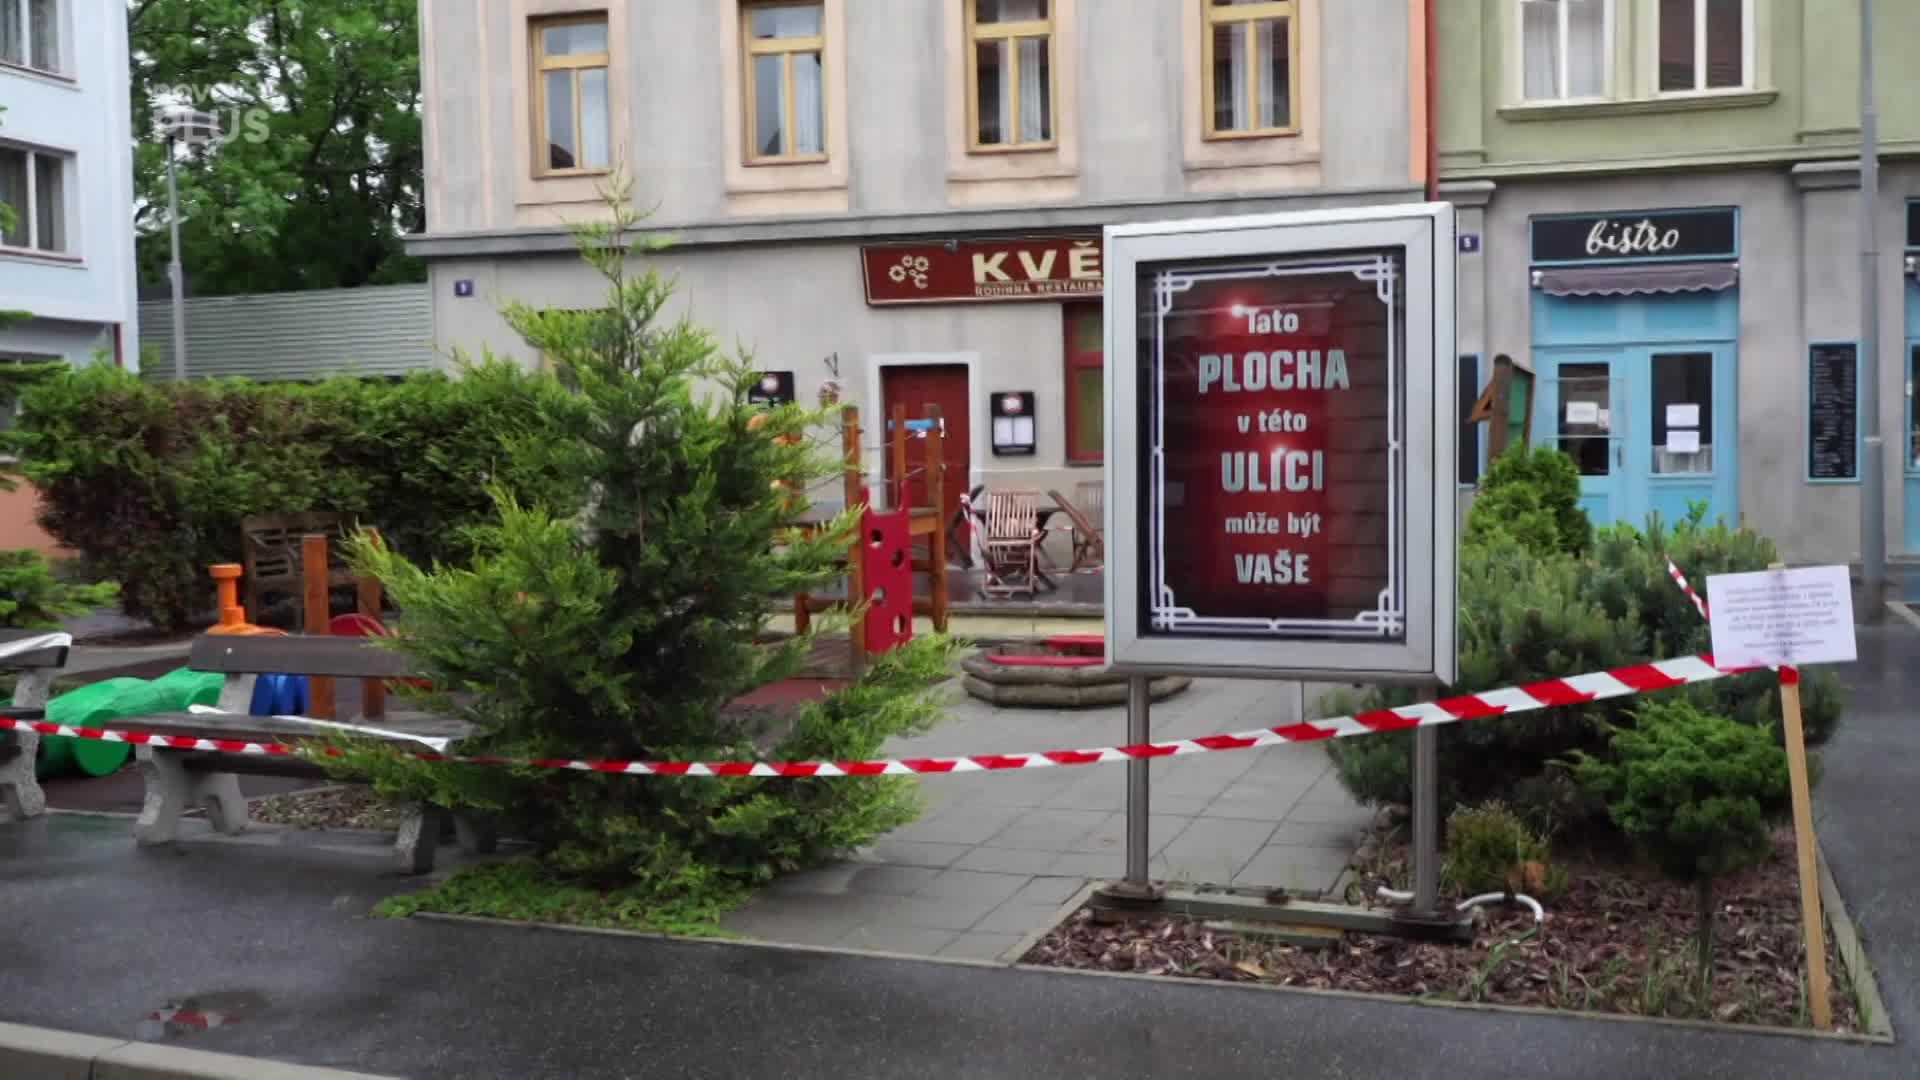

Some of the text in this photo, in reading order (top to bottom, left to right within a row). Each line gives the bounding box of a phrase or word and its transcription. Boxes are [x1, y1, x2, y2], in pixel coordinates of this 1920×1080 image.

[1585, 219, 1680, 255] bistro
[972, 241, 1101, 284] KVĚ
[1247, 308, 1299, 334] Tato
[1198, 349, 1350, 394] PLOCHA
[1237, 408, 1307, 433] v této
[1221, 450, 1323, 492] ULICI
[1225, 511, 1321, 538] může být
[1234, 549, 1311, 584] VAŠE
